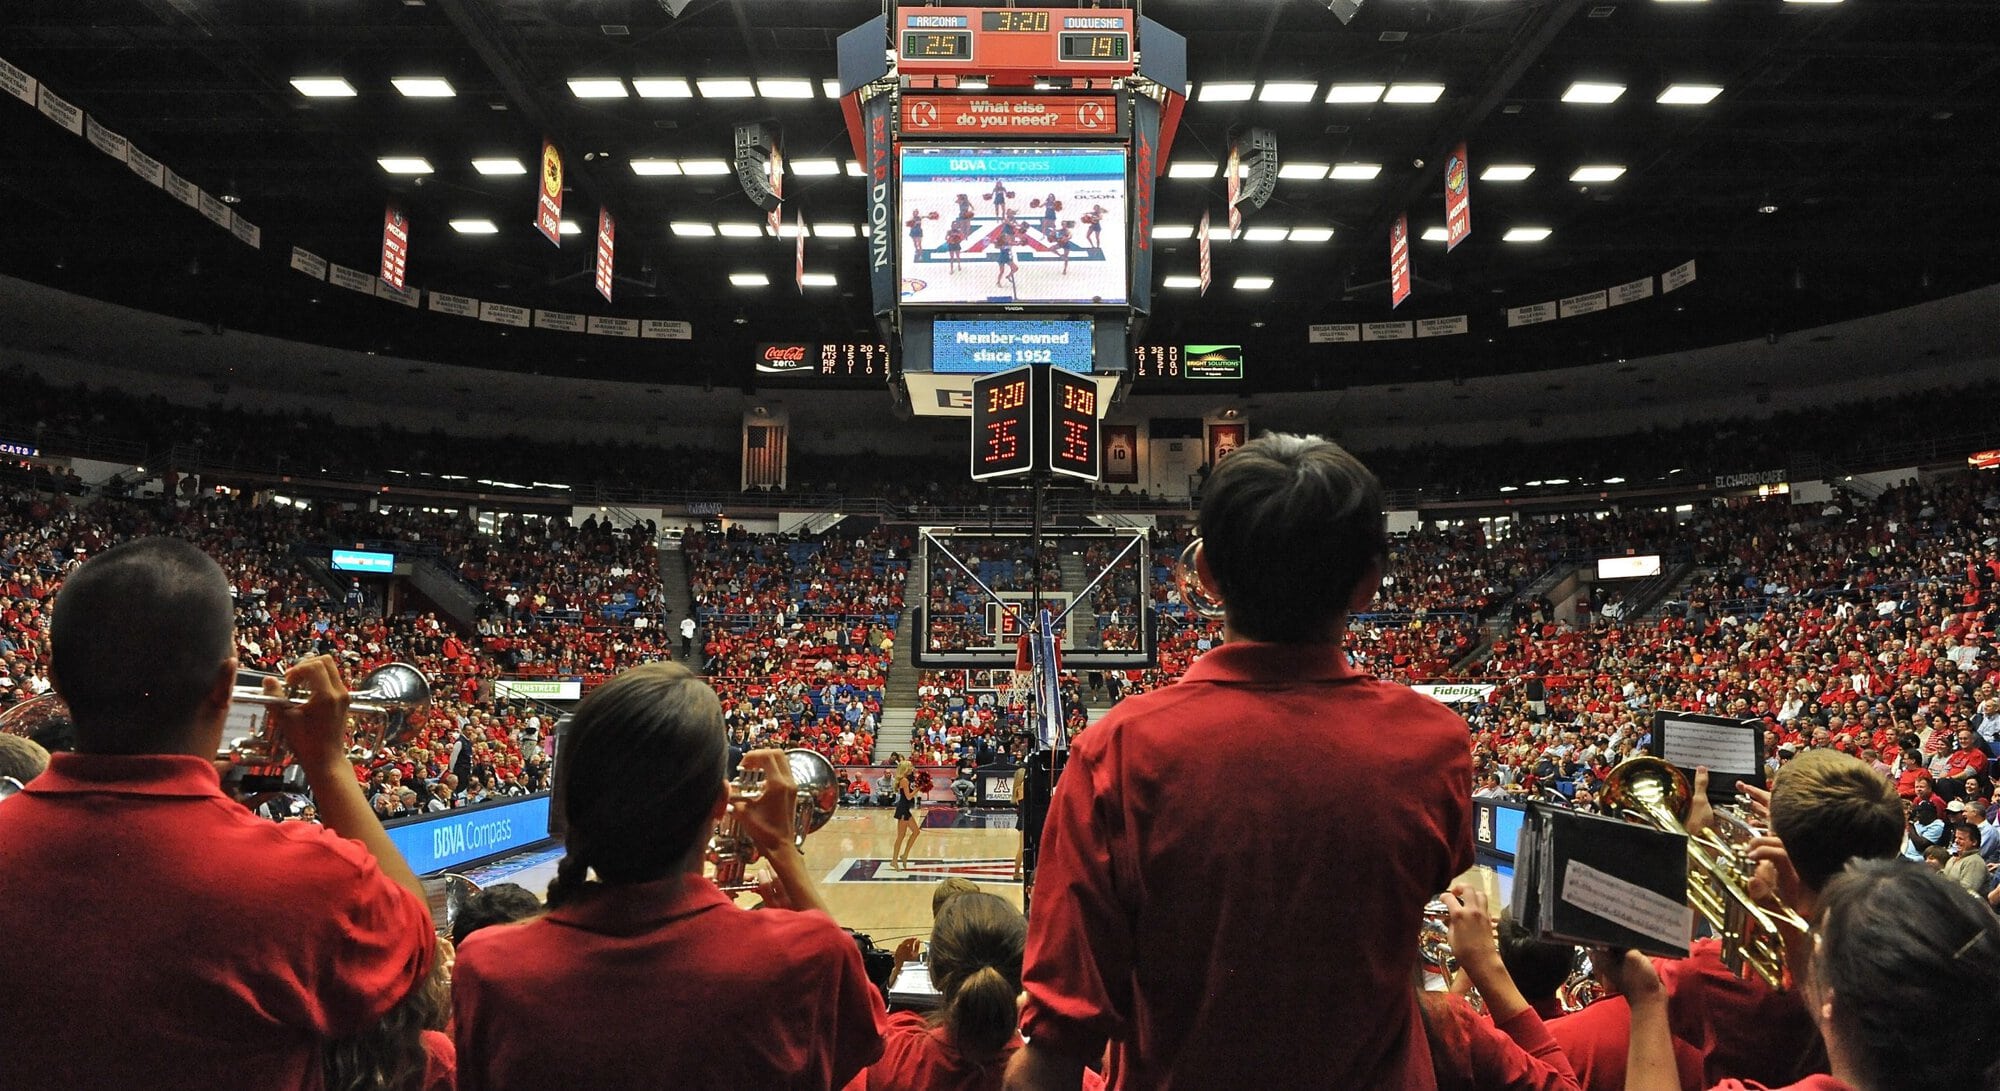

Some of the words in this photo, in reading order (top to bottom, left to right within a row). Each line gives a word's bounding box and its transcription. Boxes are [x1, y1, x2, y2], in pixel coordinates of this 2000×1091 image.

[917, 16, 959, 28] ARIZONA
[999, 12, 1049, 32] 3:20
[1069, 18, 1120, 29] DUQUESNE
[926, 36, 955, 55] 25
[1092, 37, 1113, 57] 19
[970, 101, 1010, 114] What
[1014, 102, 1045, 114] else
[957, 114, 976, 126] do
[980, 117, 1008, 129] you
[1012, 113, 1059, 127] need?
[950, 159, 987, 172] BBVA
[989, 159, 1050, 174] Compass
[1452, 216, 1465, 240] 2001
[956, 332, 1069, 344] Member-owned
[860, 344, 873, 352] 20
[974, 349, 1011, 362] since
[1016, 350, 1051, 362] 1952
[822, 352, 836, 360] PTS
[988, 381, 1025, 413] 3:20
[1064, 385, 1094, 416] 3:20
[985, 419, 1017, 462] 35
[1062, 420, 1088, 462] 35
[1113, 449, 1126, 460] 10
[1433, 686, 1481, 697] Fidelity
[433, 822, 465, 860] BBVA
[466, 818, 513, 850] Compass
